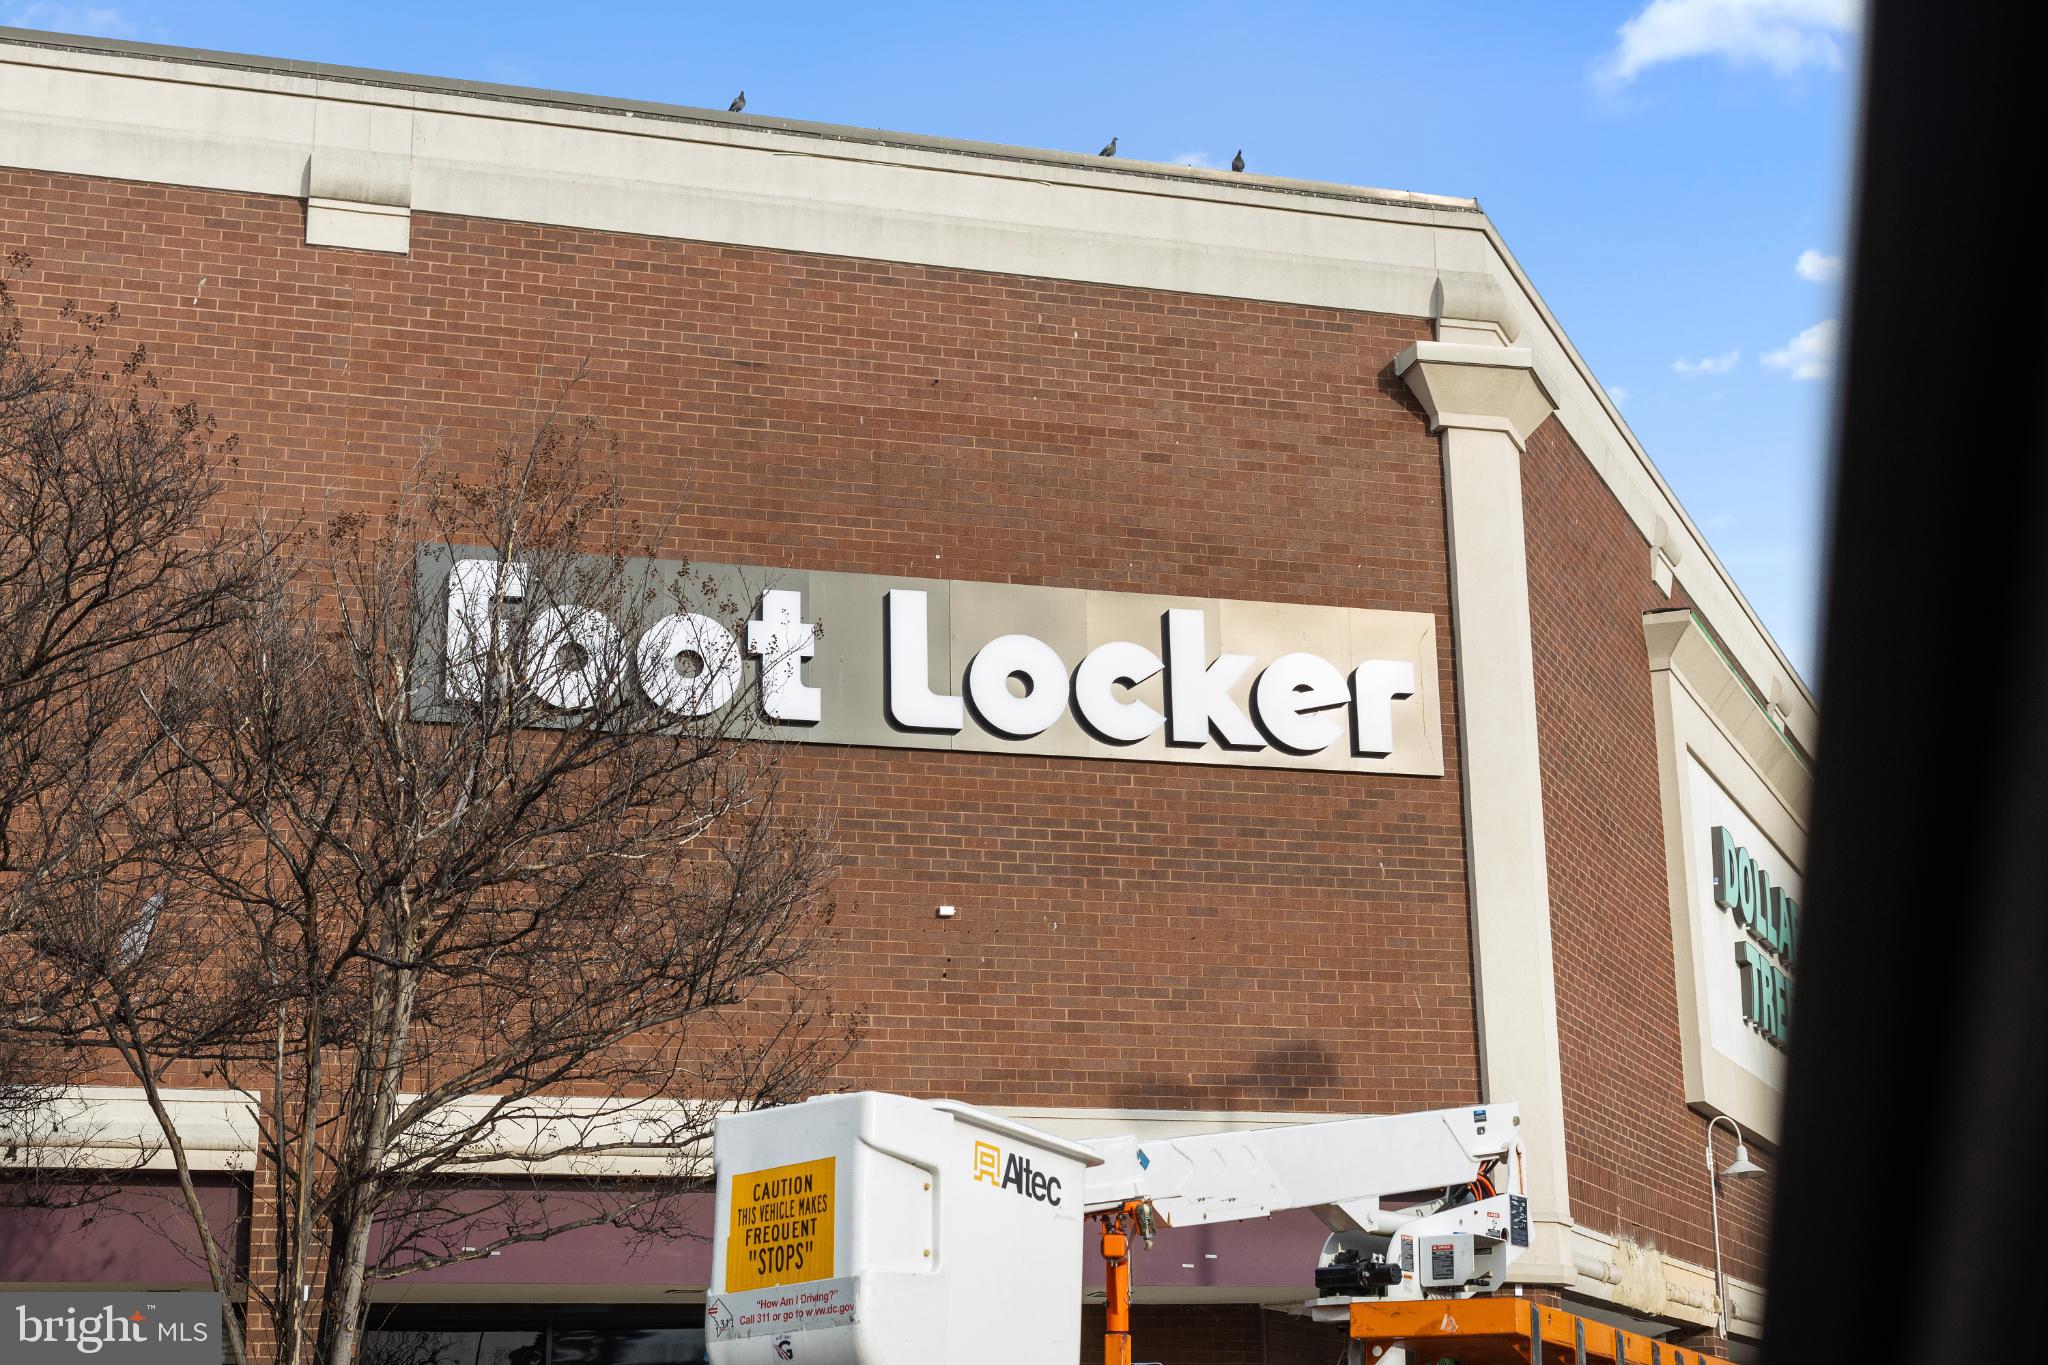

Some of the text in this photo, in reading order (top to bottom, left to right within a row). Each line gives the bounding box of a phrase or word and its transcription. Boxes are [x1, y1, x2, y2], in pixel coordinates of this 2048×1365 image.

[884, 588, 1415, 758] Locker
[1735, 941, 1793, 1045] TRE
[753, 1174, 813, 1202] CAUTION
[1001, 1152, 1062, 1207] Altec
[738, 1193, 828, 1227] THIS VEHICLE MAKES
[745, 1217, 817, 1246] FREQUENT
[749, 1240, 814, 1275] "STOPS"
[739, 1315, 755, 1325] Call
[757, 1313, 770, 1323] 311
[772, 1312, 782, 1321] or
[783, 1311, 793, 1321] go
[795, 1309, 804, 1318] to
[780, 1297, 794, 1306] Am
